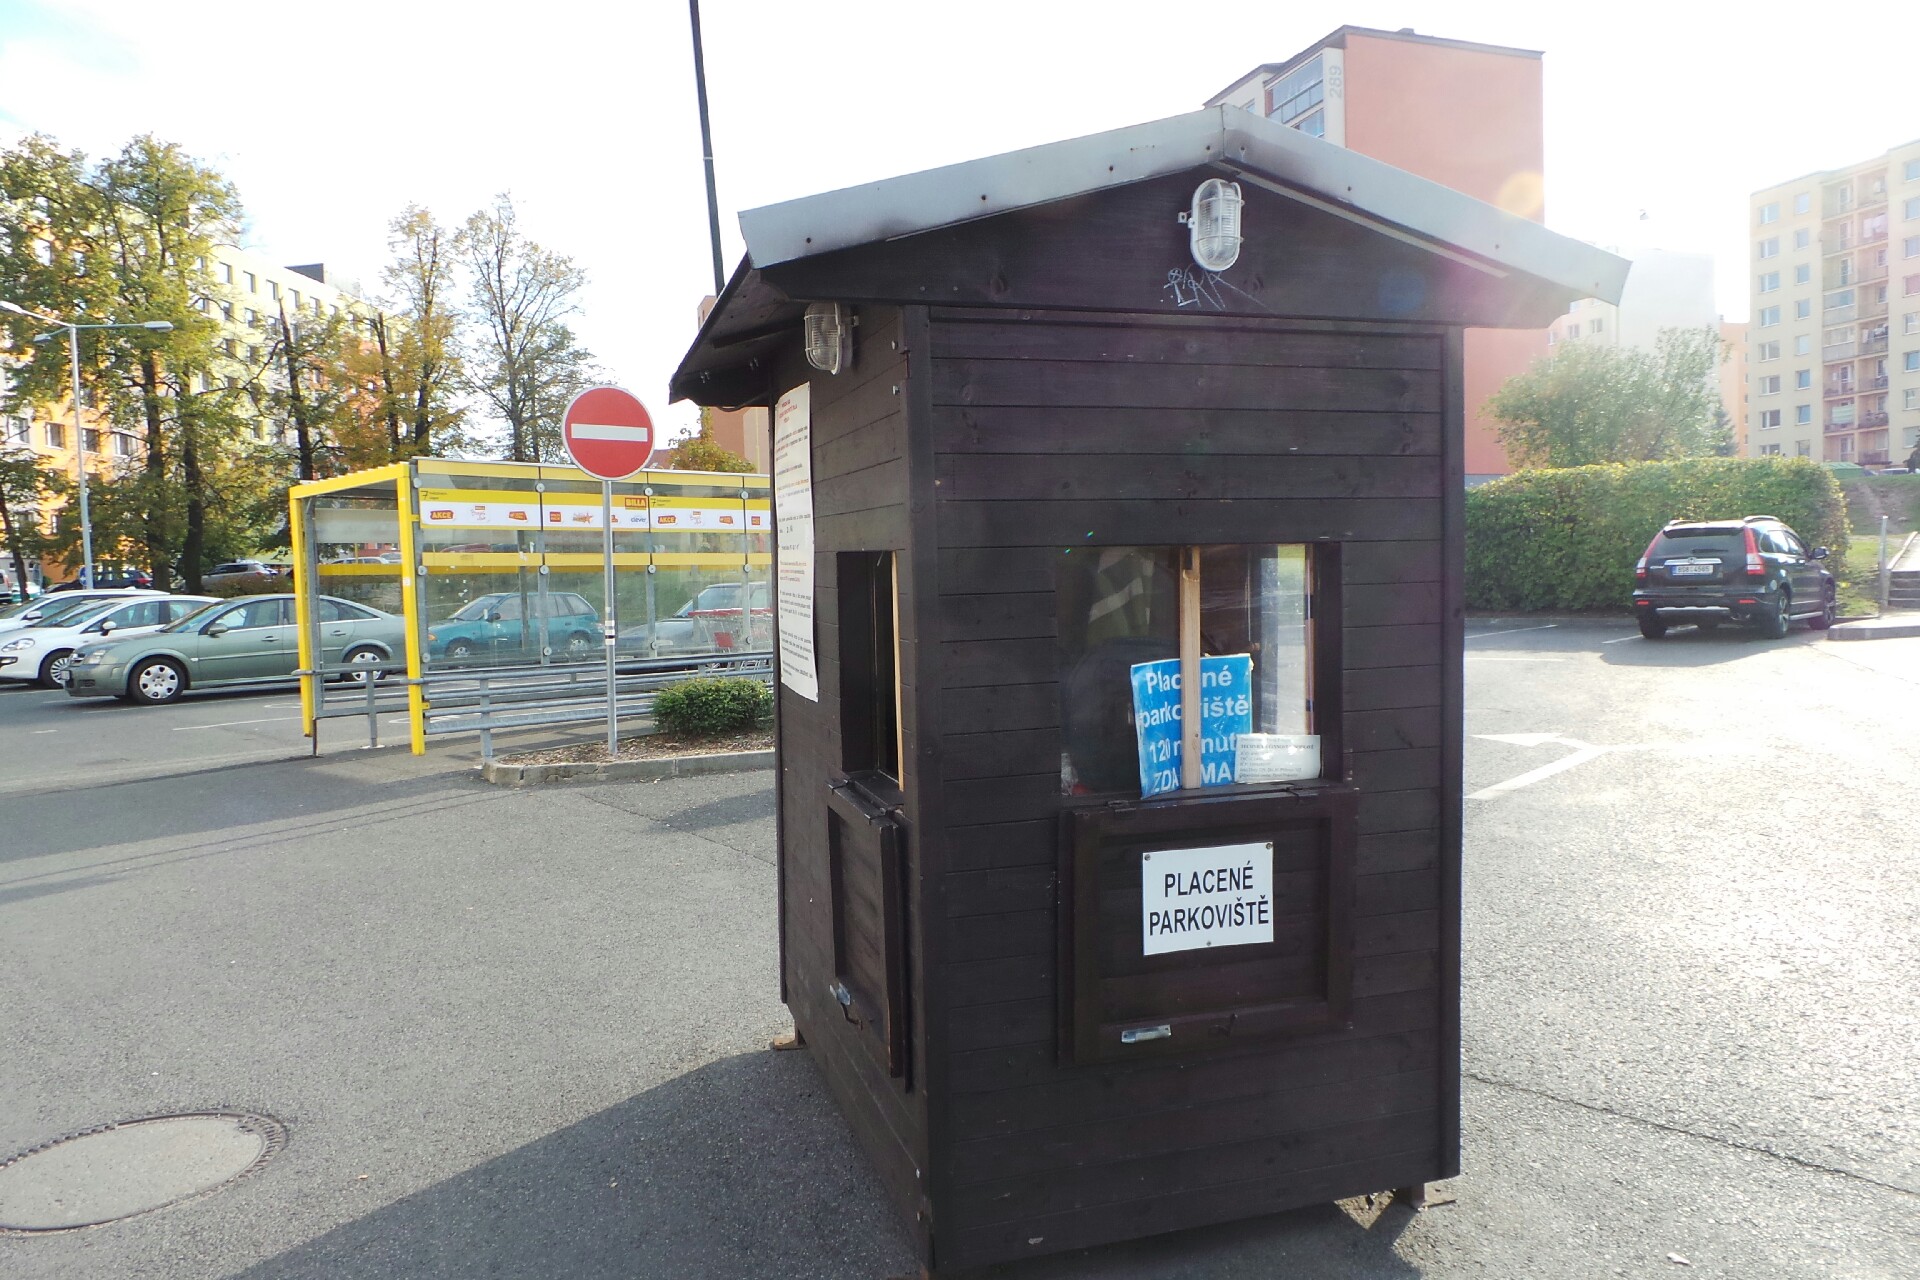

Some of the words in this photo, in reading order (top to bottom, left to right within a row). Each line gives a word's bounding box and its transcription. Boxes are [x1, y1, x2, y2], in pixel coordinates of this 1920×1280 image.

[431, 511, 453, 519] AKCE
[625, 498, 646, 507] BILLA
[1145, 665, 1232, 694] Placné
[1139, 694, 1249, 728] parkoiště
[1149, 738, 1171, 763] 120
[1151, 761, 1233, 793] ZDAMA
[1165, 860, 1253, 898] PLACENÉ
[1149, 894, 1269, 936] PARKOVIŠTĚ
